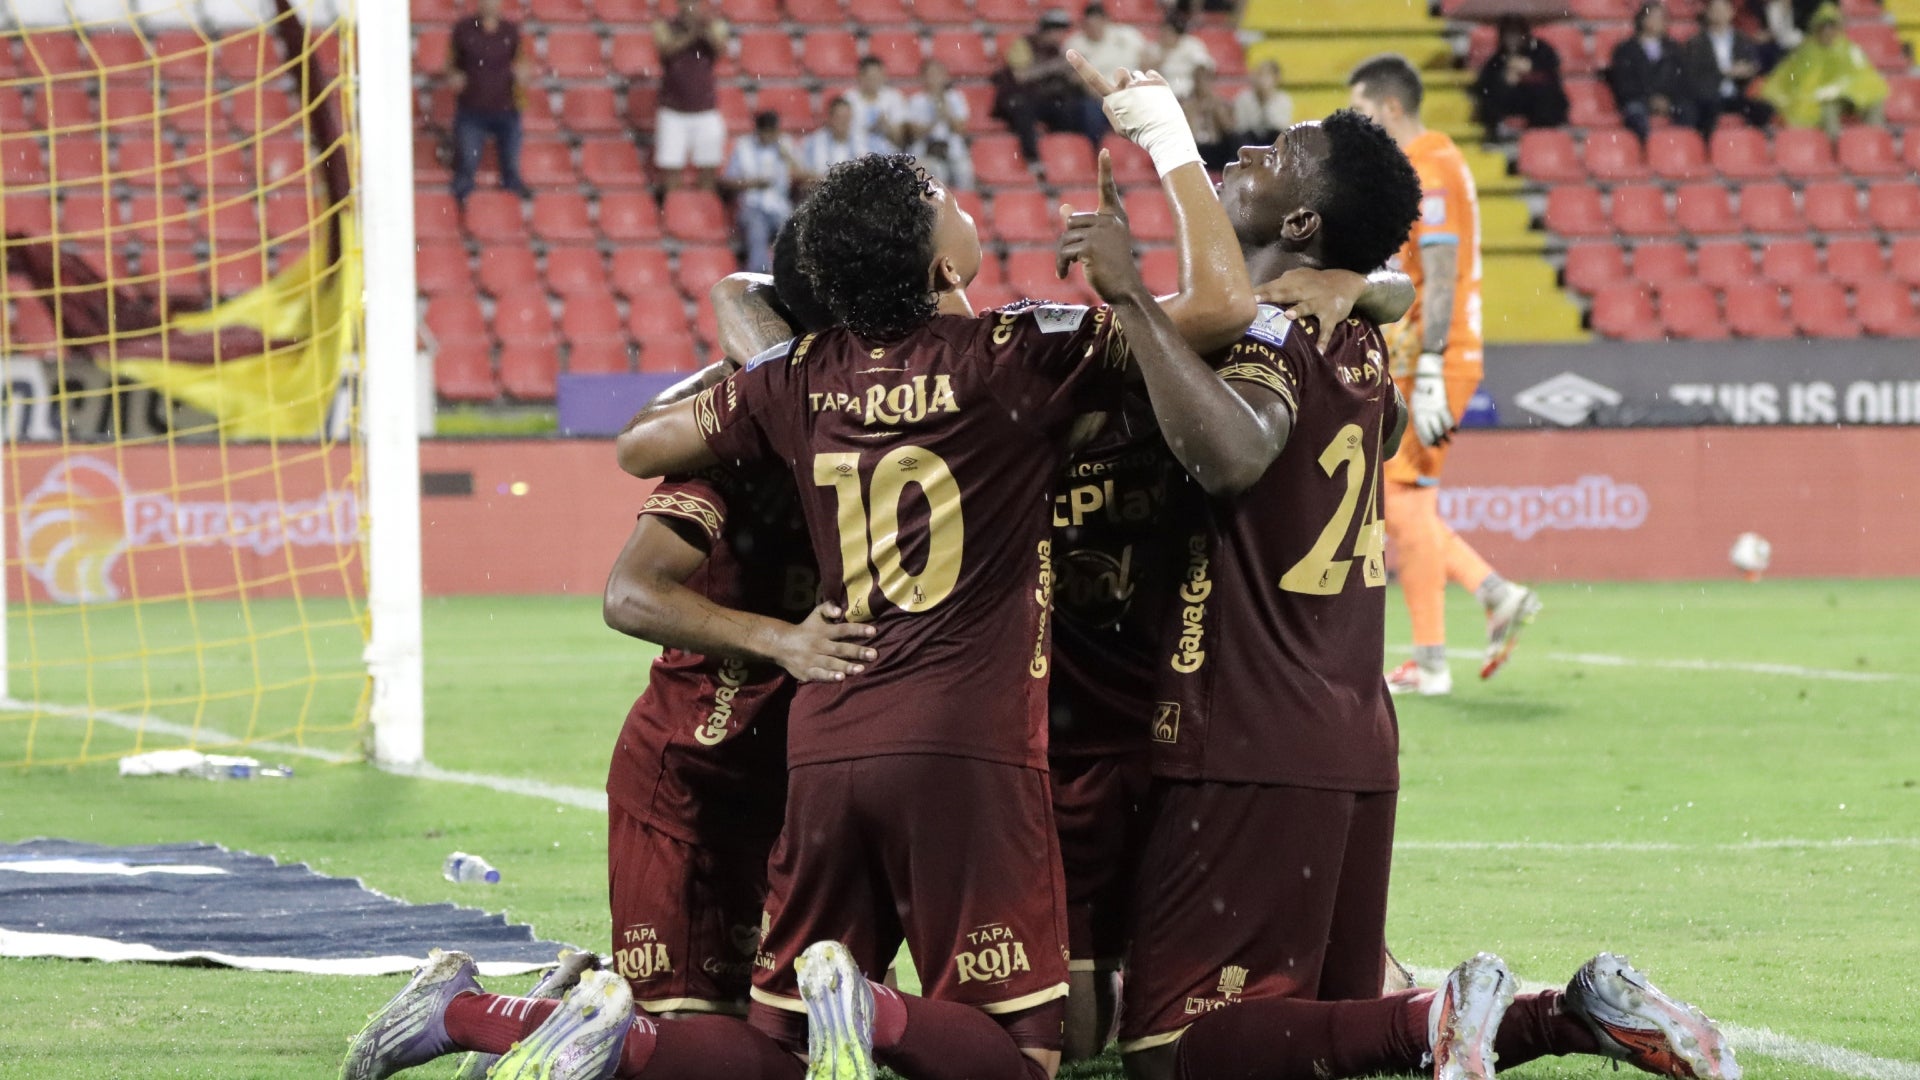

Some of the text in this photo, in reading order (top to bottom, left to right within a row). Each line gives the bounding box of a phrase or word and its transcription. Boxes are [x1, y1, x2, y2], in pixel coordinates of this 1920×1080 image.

[809, 375, 960, 426] TAPA ROJA
[1788, 382, 1837, 425] IS
[132, 496, 357, 553] Puropoll
[1279, 413, 1387, 595] 24
[1438, 479, 1647, 538] uropollo
[813, 445, 964, 623] 10
[694, 655, 749, 746] GanaGa
[624, 928, 657, 944] TAPA
[967, 926, 1014, 945] TAPA
[615, 942, 674, 979] ROJA
[754, 955, 776, 971] LIMA
[955, 942, 1031, 984] ROJA
